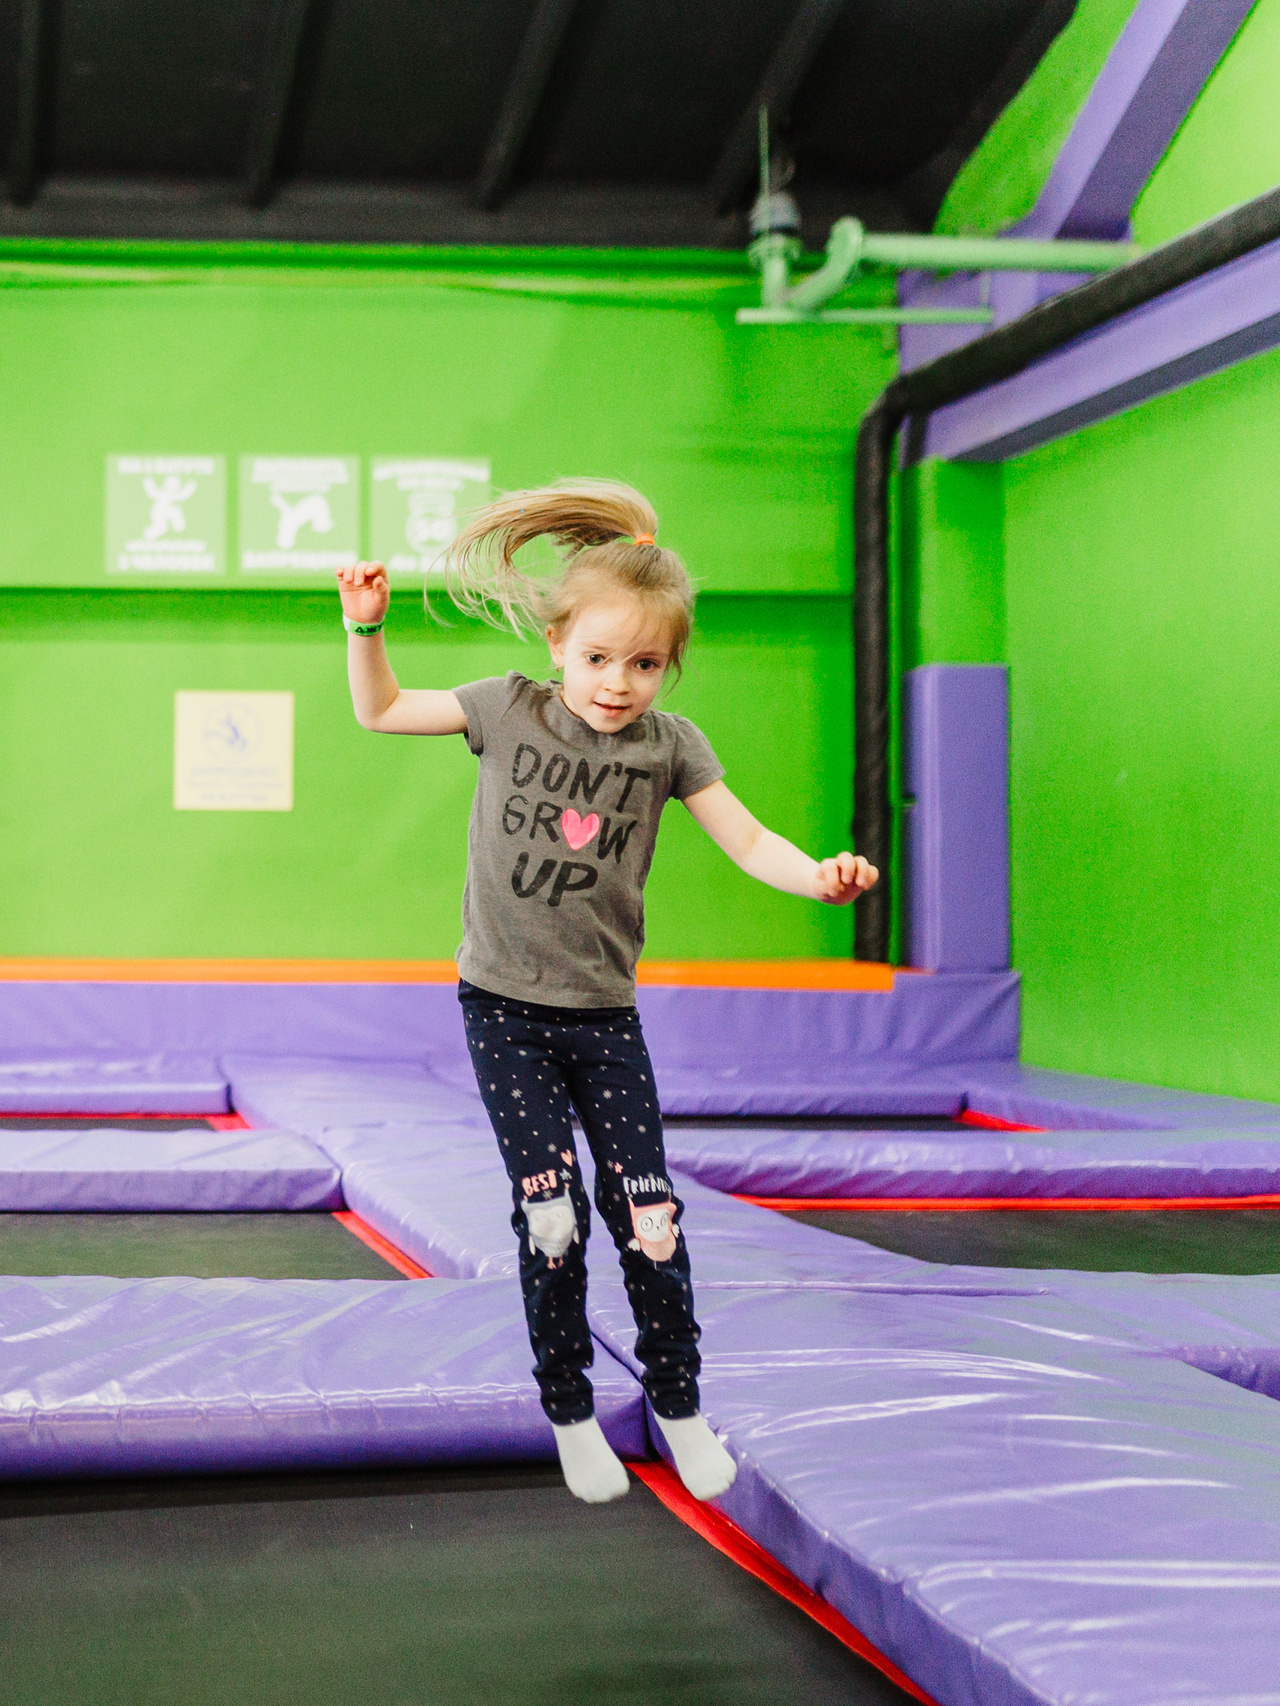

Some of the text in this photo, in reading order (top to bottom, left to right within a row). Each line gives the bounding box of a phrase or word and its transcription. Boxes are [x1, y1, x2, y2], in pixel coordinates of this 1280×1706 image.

[512, 743, 650, 813] DON'T
[511, 851, 598, 907] UP
[522, 1169, 558, 1197] BEST
